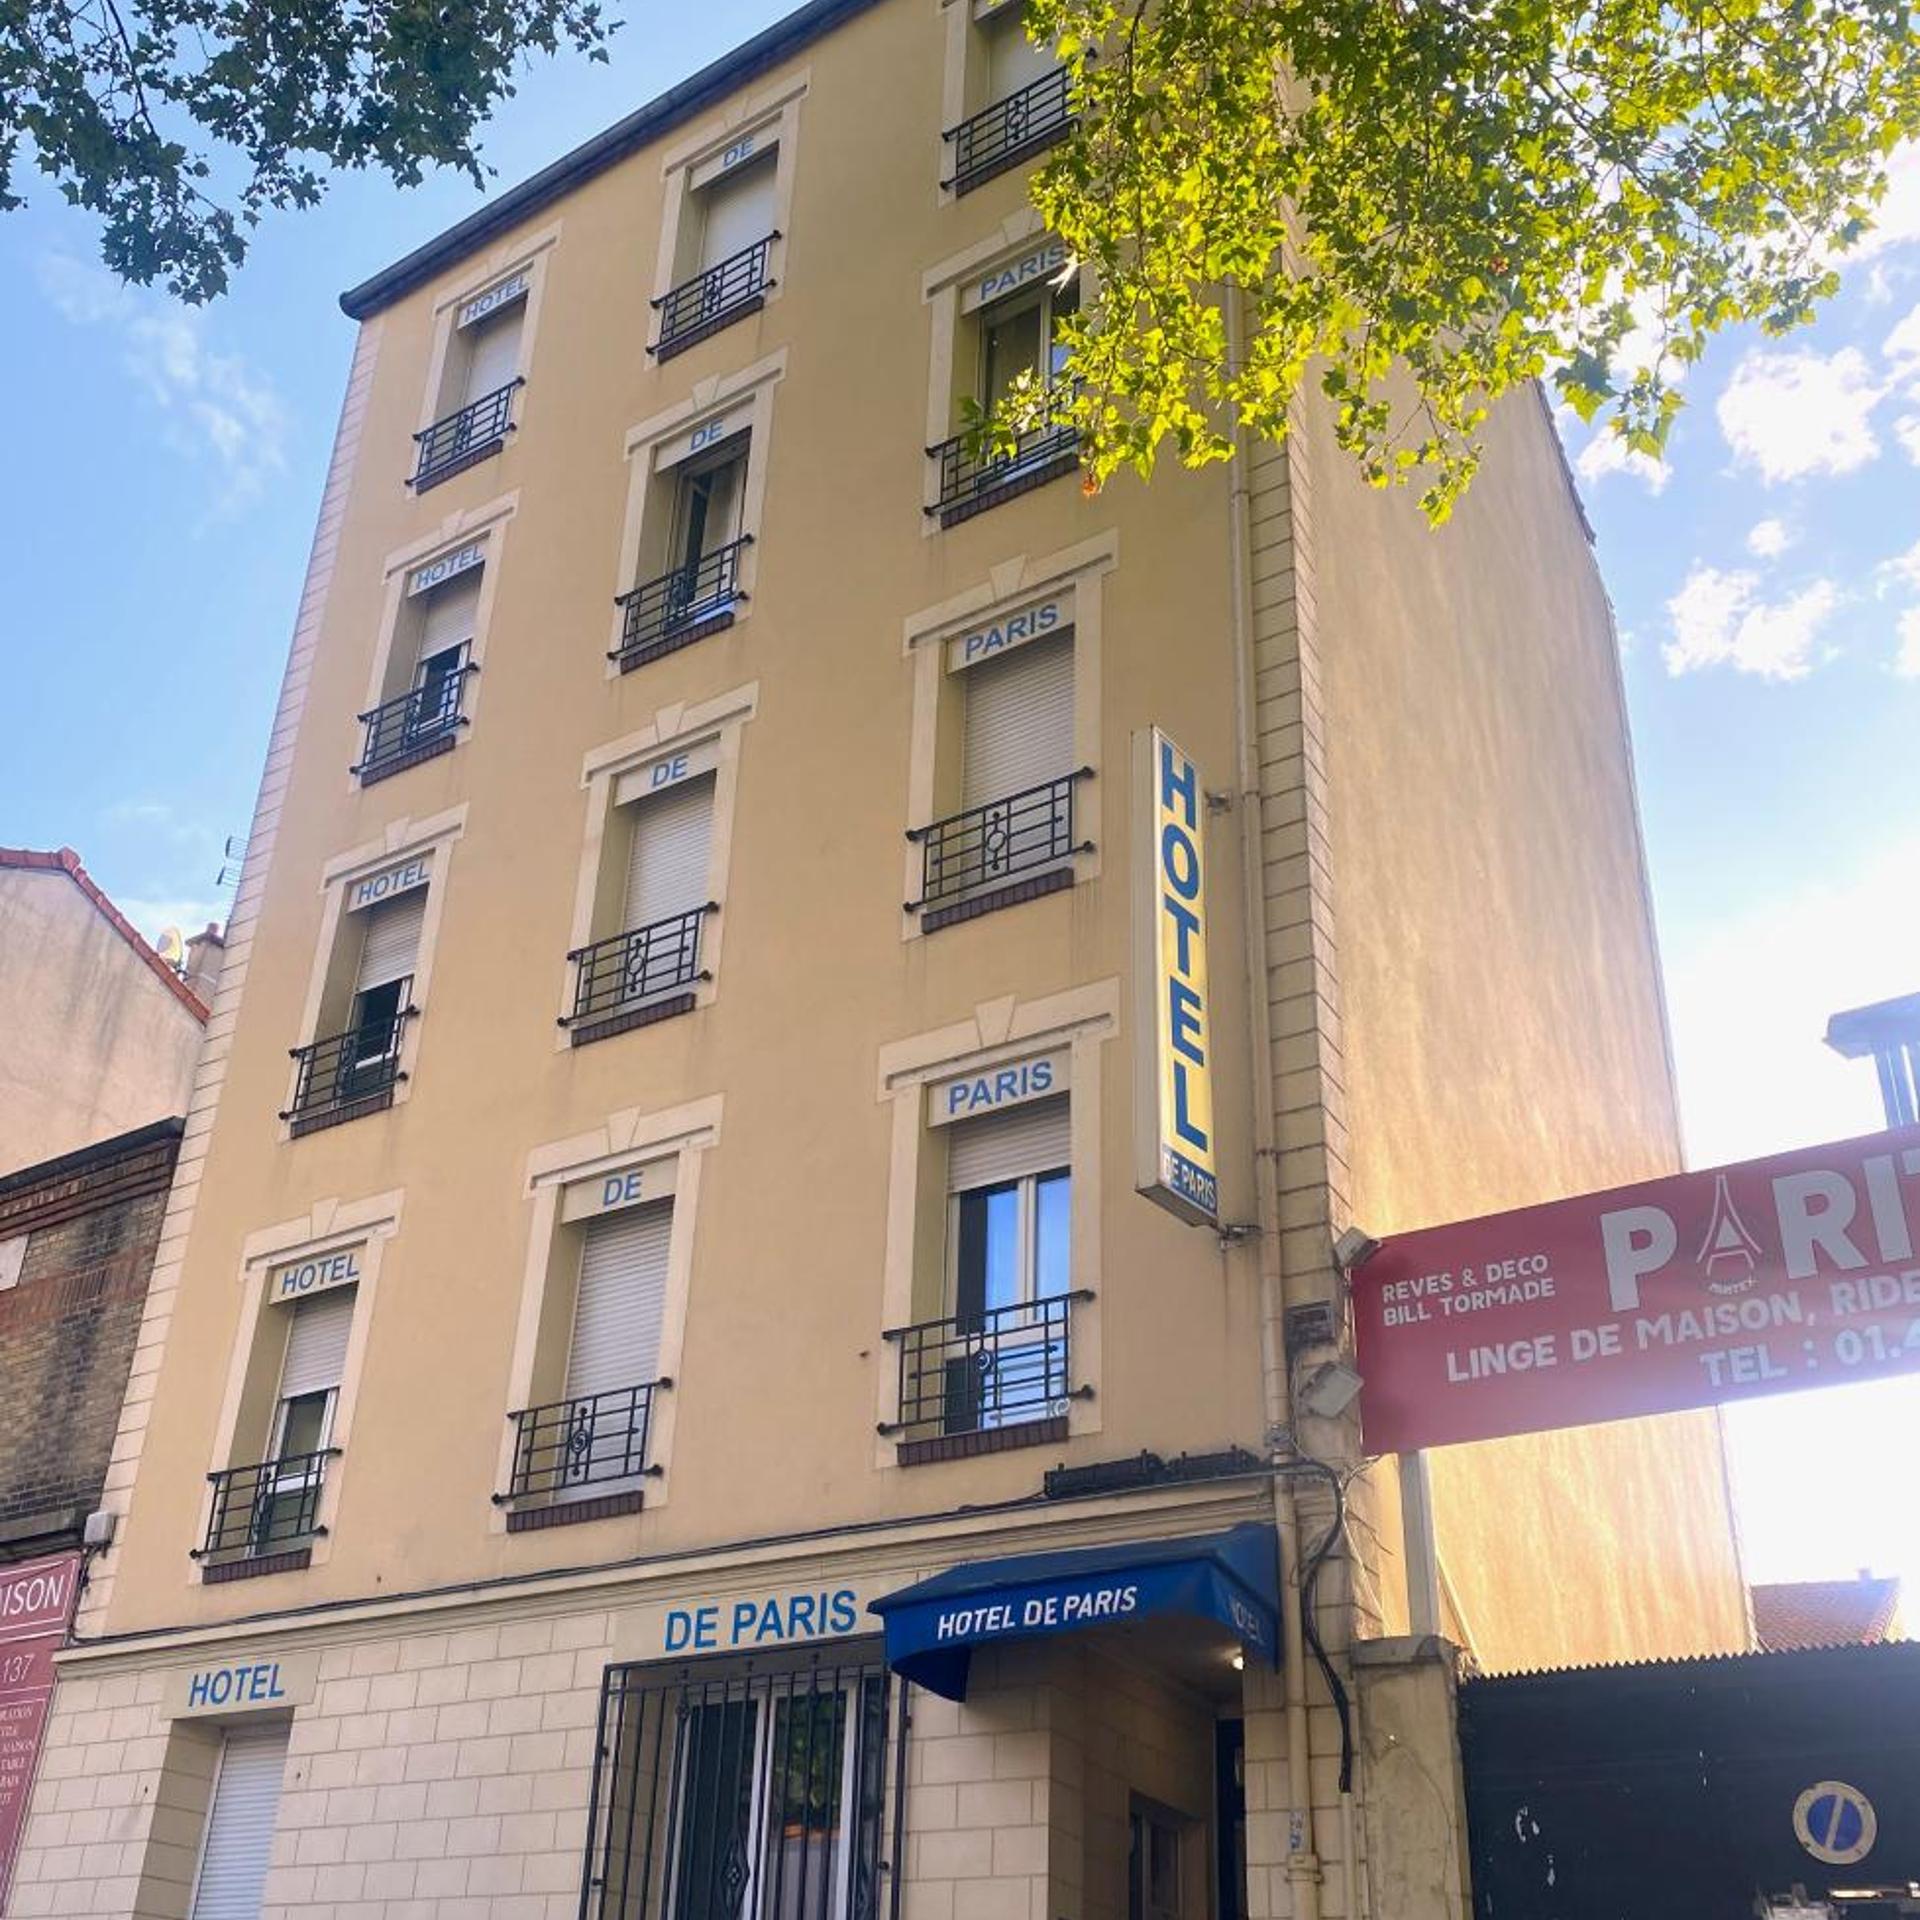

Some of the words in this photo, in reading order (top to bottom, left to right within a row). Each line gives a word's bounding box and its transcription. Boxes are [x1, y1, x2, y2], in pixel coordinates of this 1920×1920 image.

[723, 137, 754, 168] DE
[981, 243, 1064, 300] PARIS
[465, 274, 527, 322] HOTEL
[690, 418, 724, 451] DE
[416, 545, 484, 589] HOTEL
[965, 604, 1059, 661] PARIS
[652, 754, 689, 787] DE
[357, 861, 429, 904] HOTEL
[1161, 741, 1208, 1153] HOTEL
[949, 1061, 1053, 1114] PARIS
[602, 1170, 644, 1206] DE
[1181, 1164, 1216, 1209] PARIS
[1600, 1148, 1920, 1312] PARI
[281, 1254, 359, 1295] HOTEL
[1382, 1273, 1453, 1303] REVES
[1462, 1268, 1478, 1287] &
[1486, 1254, 1549, 1283] DECO
[1383, 1302, 1431, 1327] BILL
[1441, 1278, 1556, 1316] TORMADE
[1446, 1335, 1557, 1382] LINGE
[1570, 1323, 1622, 1361] DE
[1635, 1290, 1815, 1350] MAISON,
[1700, 1343, 1788, 1387] TEL
[0, 1574, 65, 1616] ISON
[937, 1605, 1016, 1640] HOTEL
[1023, 1597, 1058, 1626] DE
[1063, 1586, 1138, 1621] PARIS
[665, 1606, 720, 1652] DE
[731, 1590, 857, 1644] PARIS
[188, 1663, 285, 1707] HOTEL
